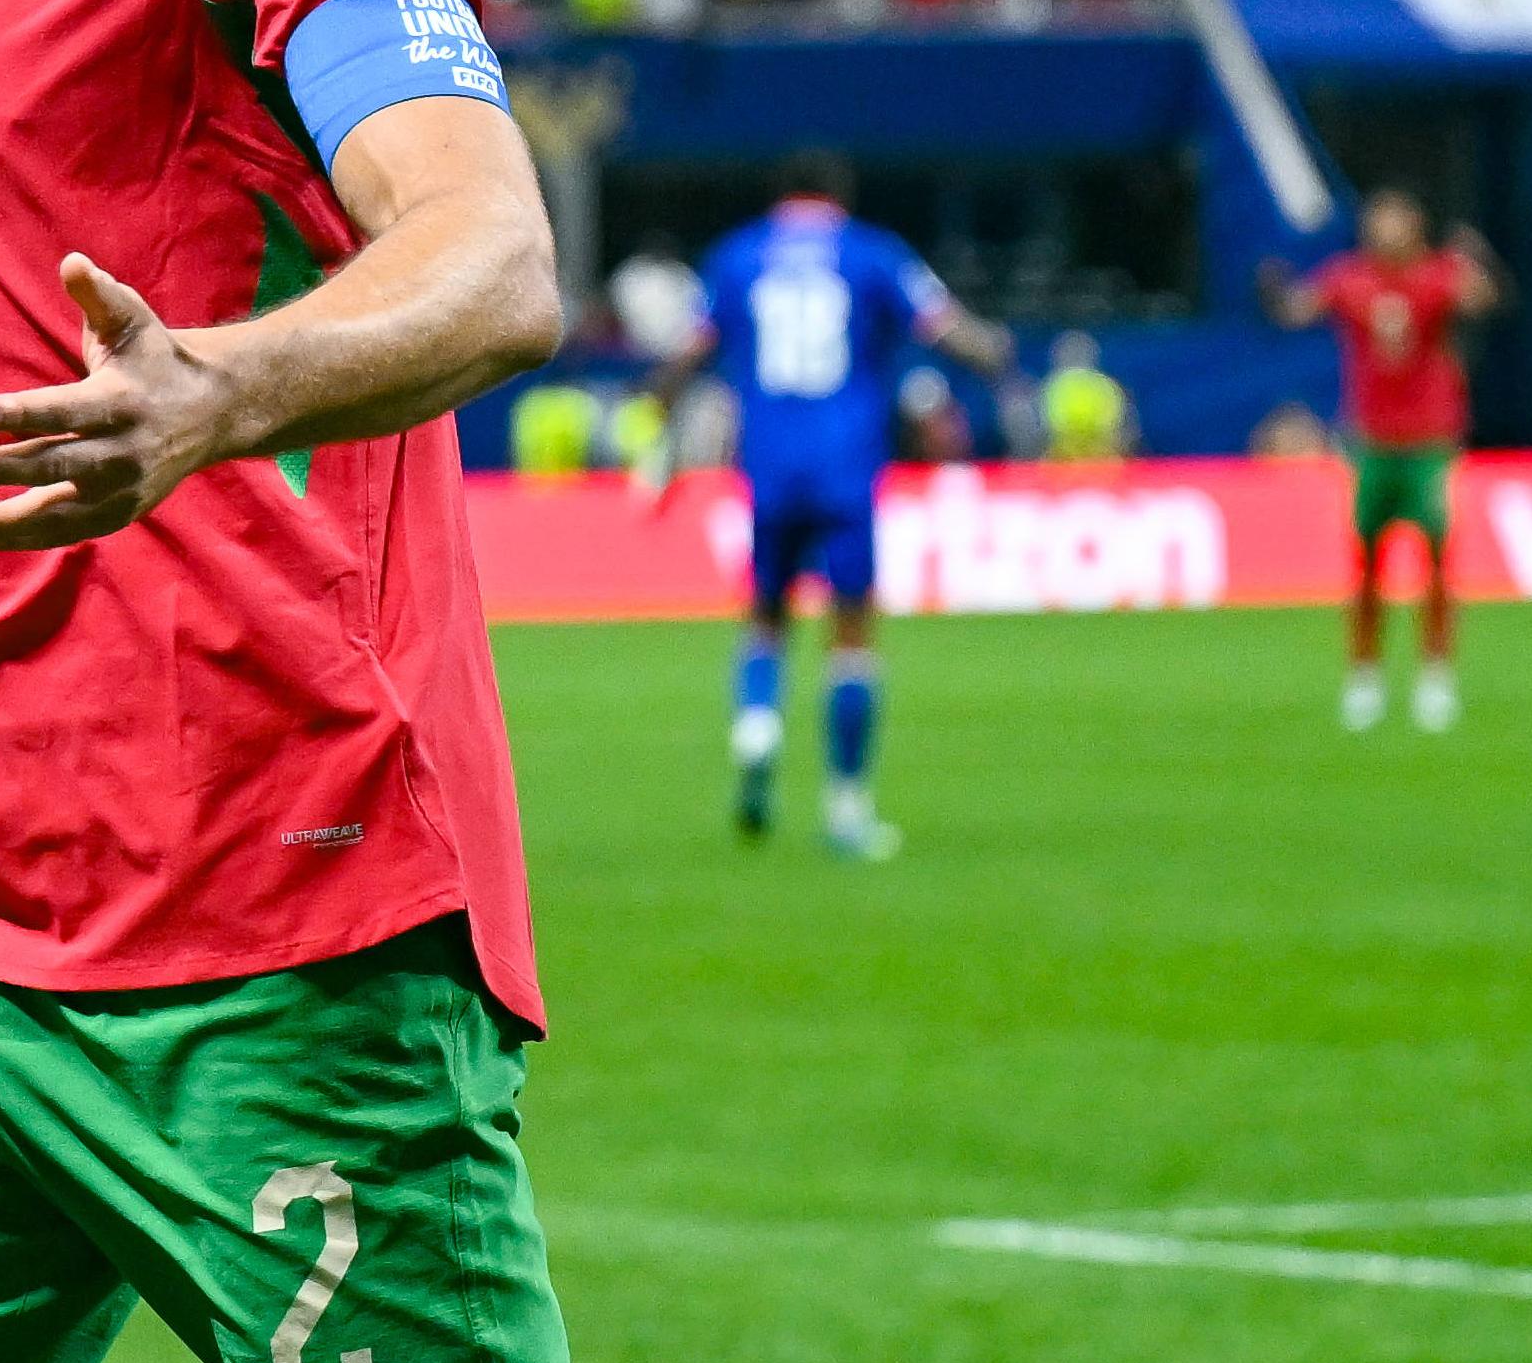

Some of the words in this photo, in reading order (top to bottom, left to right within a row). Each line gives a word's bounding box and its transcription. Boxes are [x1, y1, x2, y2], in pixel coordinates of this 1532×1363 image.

[401, 36, 457, 64] the
[458, 71, 496, 91] FIFA
[280, 823, 364, 845] ULTRAWEAVE
